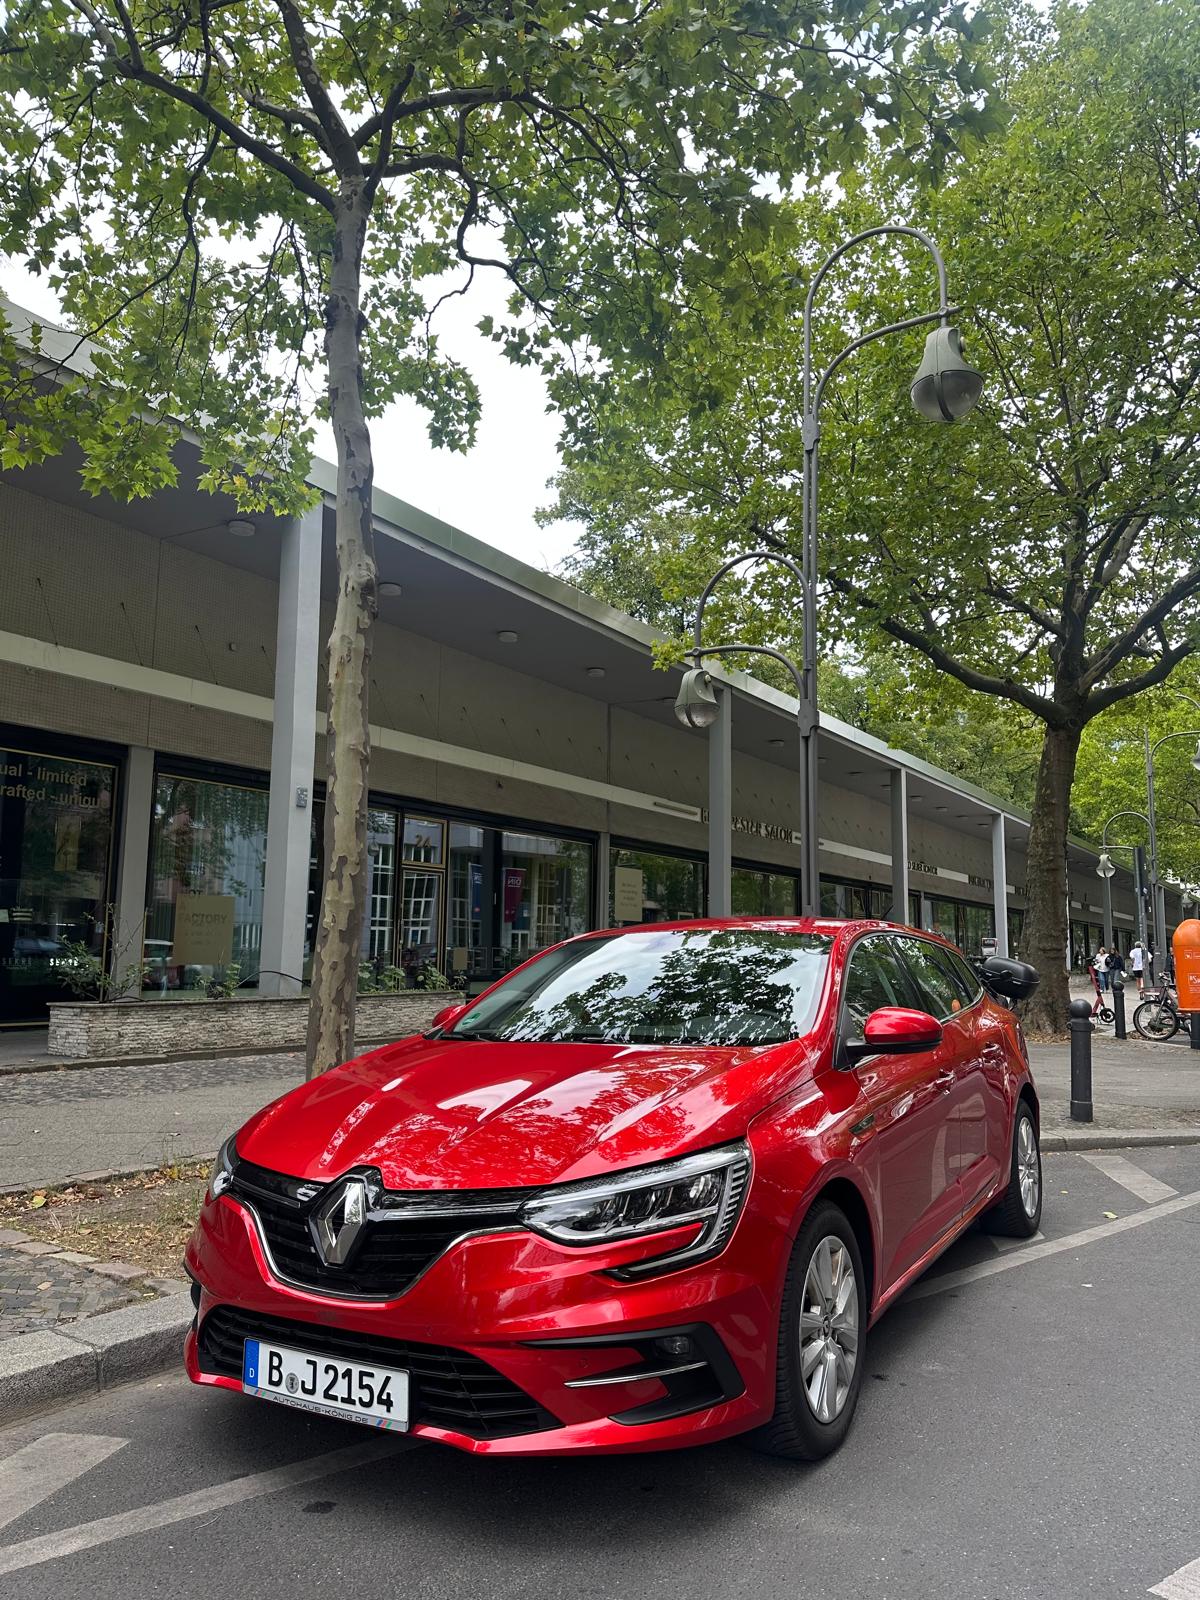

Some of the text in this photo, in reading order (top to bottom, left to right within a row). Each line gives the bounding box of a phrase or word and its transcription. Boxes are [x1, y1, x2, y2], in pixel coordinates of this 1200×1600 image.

[37, 767, 87, 786] limited
[249, 1367, 255, 1378] D
[268, 1350, 283, 1387] B
